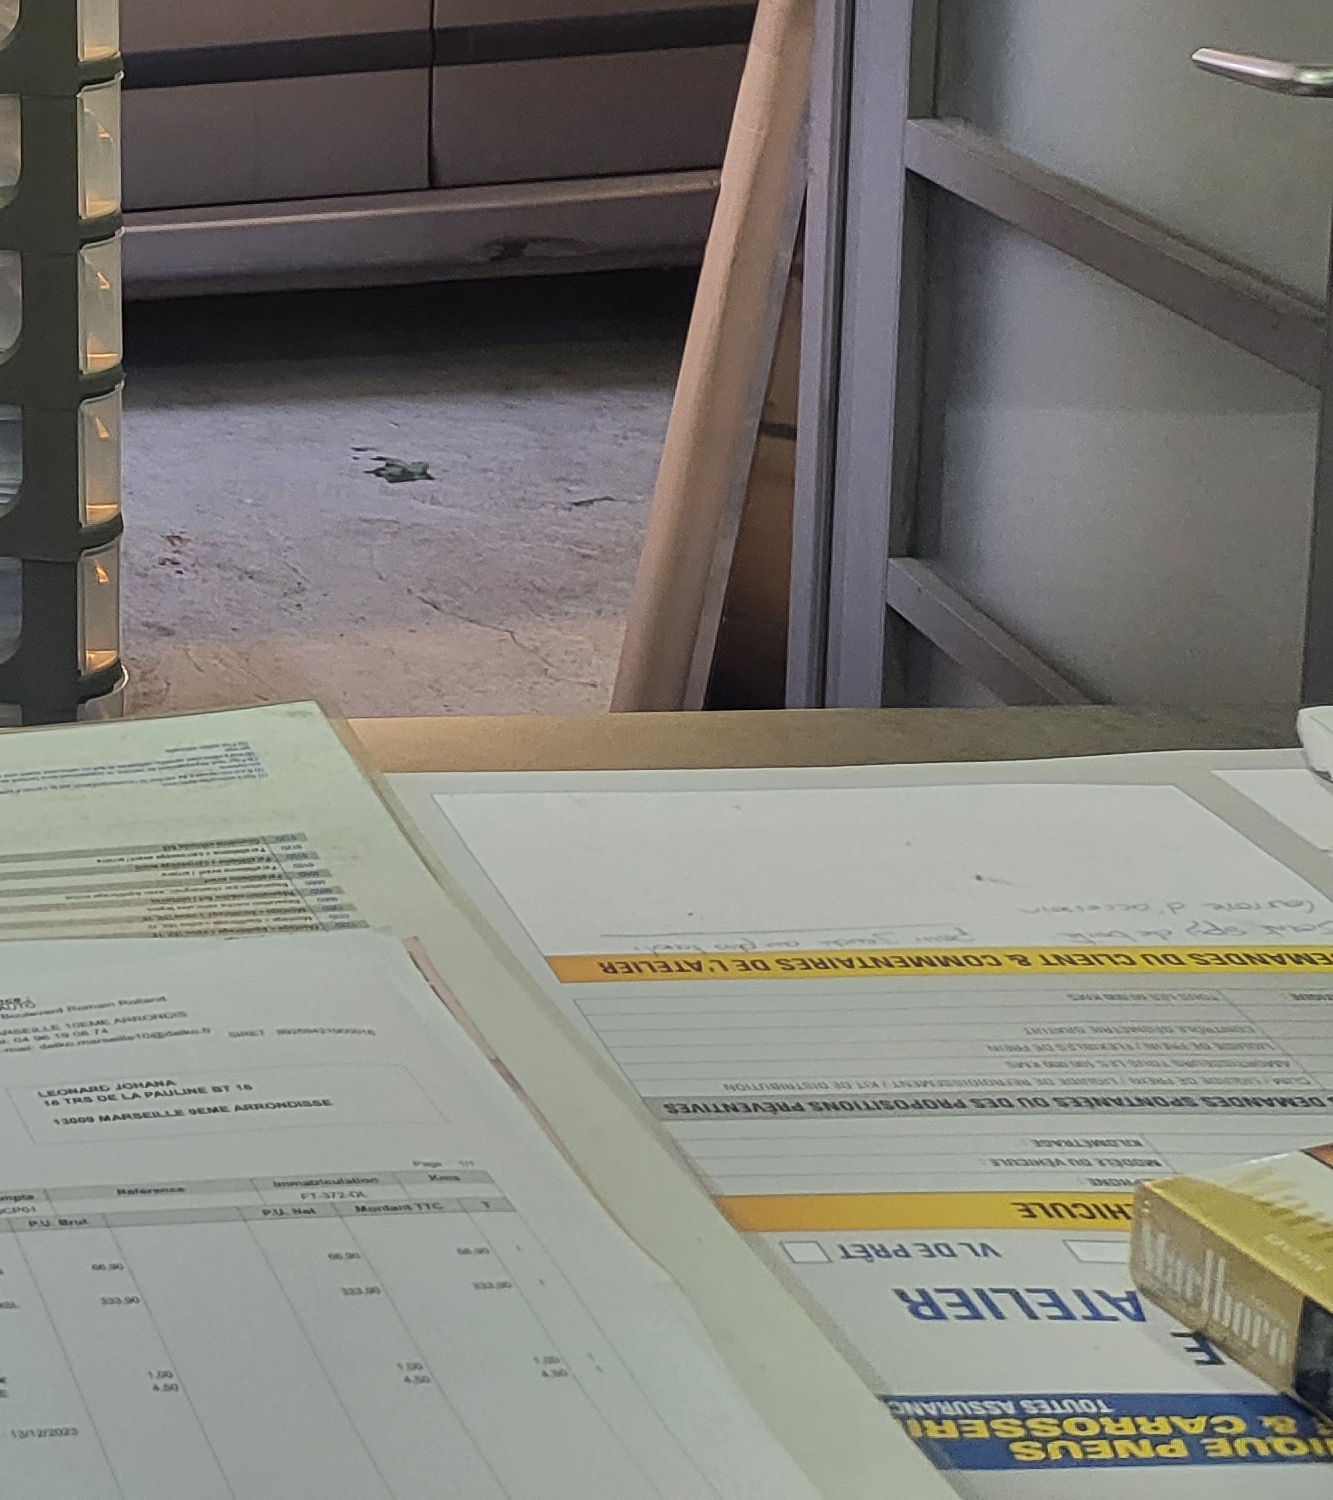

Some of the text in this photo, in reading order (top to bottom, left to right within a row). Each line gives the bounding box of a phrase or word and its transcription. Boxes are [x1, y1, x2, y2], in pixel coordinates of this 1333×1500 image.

[730, 958, 770, 972] DE
[775, 953, 1001, 972] COMMENTAIRES
[1009, 954, 1031, 967] &
[1038, 953, 1136, 967] CLIENT
[1141, 952, 1183, 966] DU
[597, 959, 728, 975] L'ATELIER
[662, 1100, 804, 1116] PRÉVENTIVES
[807, 1098, 965, 1113] PROPOSITIONS
[969, 1097, 1015, 1112] DES
[1016, 1098, 1048, 1109] OU
[1202, 1096, 1327, 1108] DEMANDES
[99, 1109, 185, 1125] MARSEILLE
[836, 1242, 1002, 1264] VL DE PRÊT
[891, 1288, 1146, 1323] ATELIER
[1018, 1398, 1112, 1414] TOUTES
[1008, 1438, 1188, 1462] PNEUS
